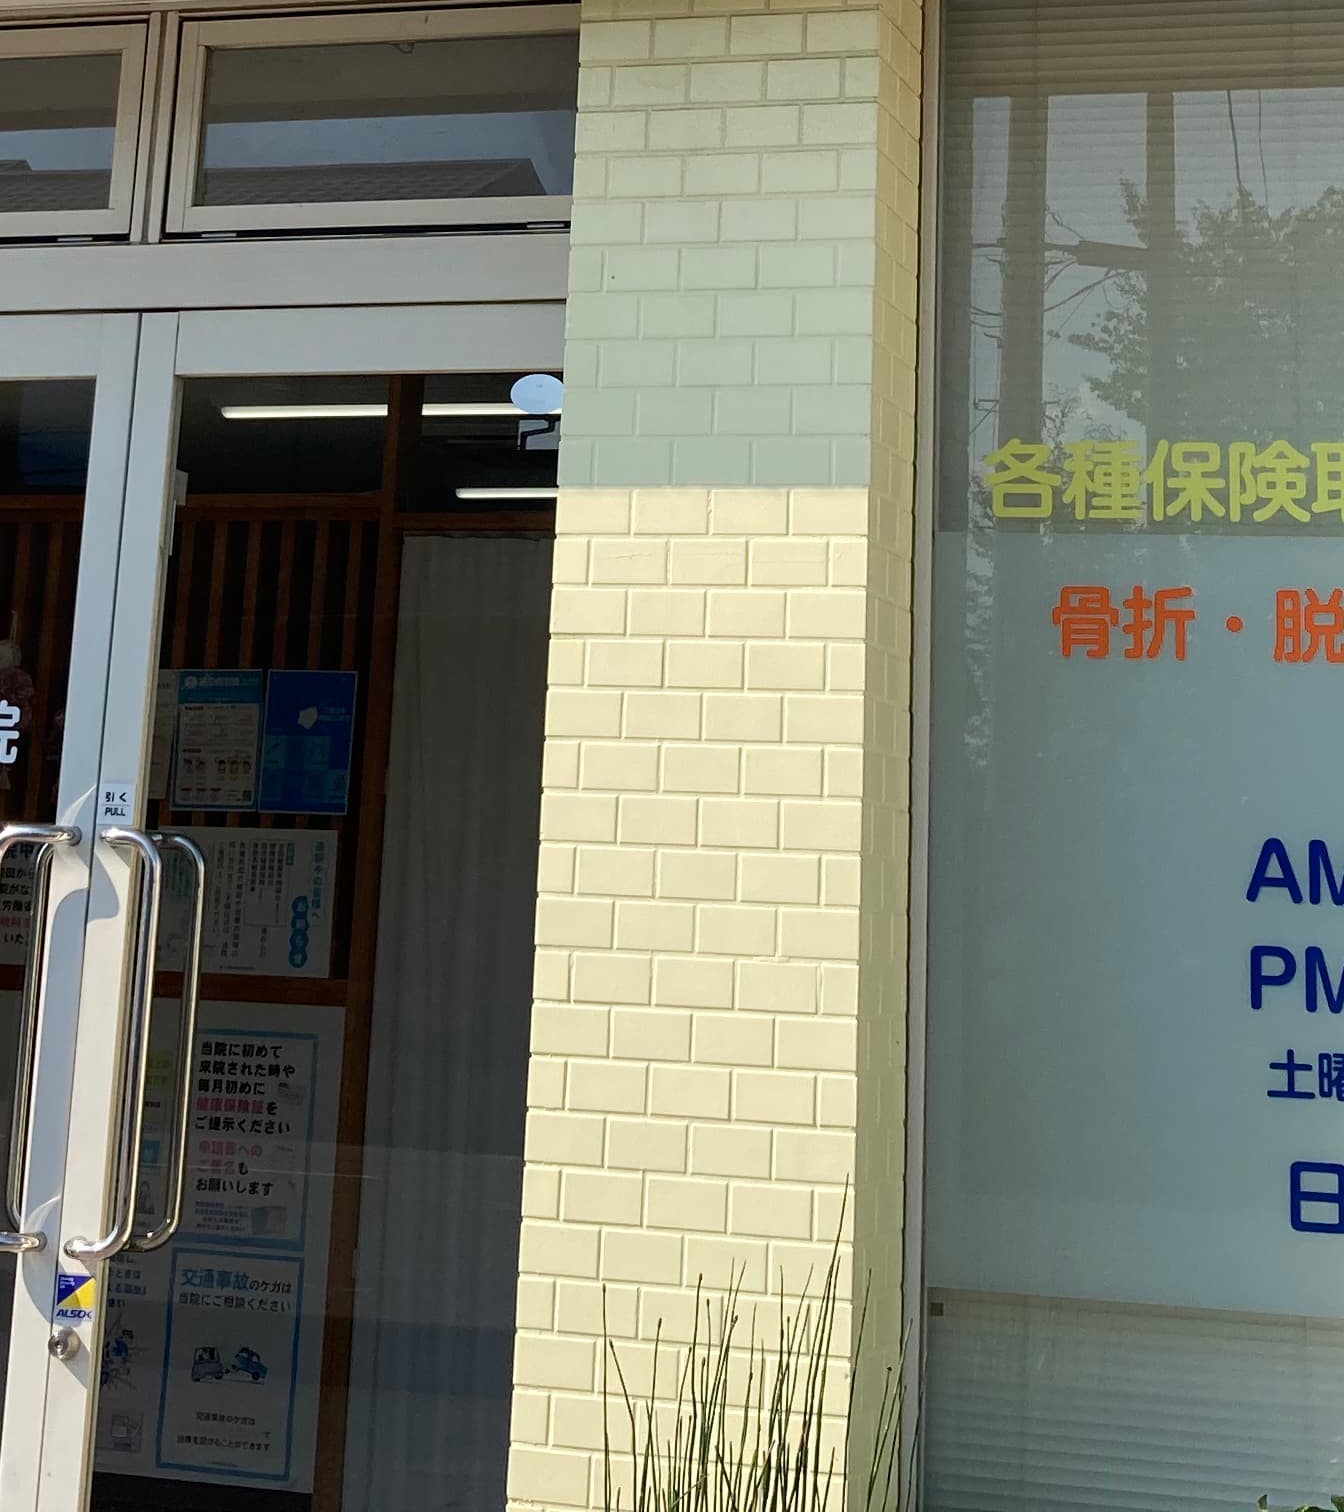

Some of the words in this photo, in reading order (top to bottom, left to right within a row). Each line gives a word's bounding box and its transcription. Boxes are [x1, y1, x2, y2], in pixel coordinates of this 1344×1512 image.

[105, 791, 127, 803] 引く
[104, 806, 126, 817] PULL
[56, 1308, 94, 1320] ALSOK
